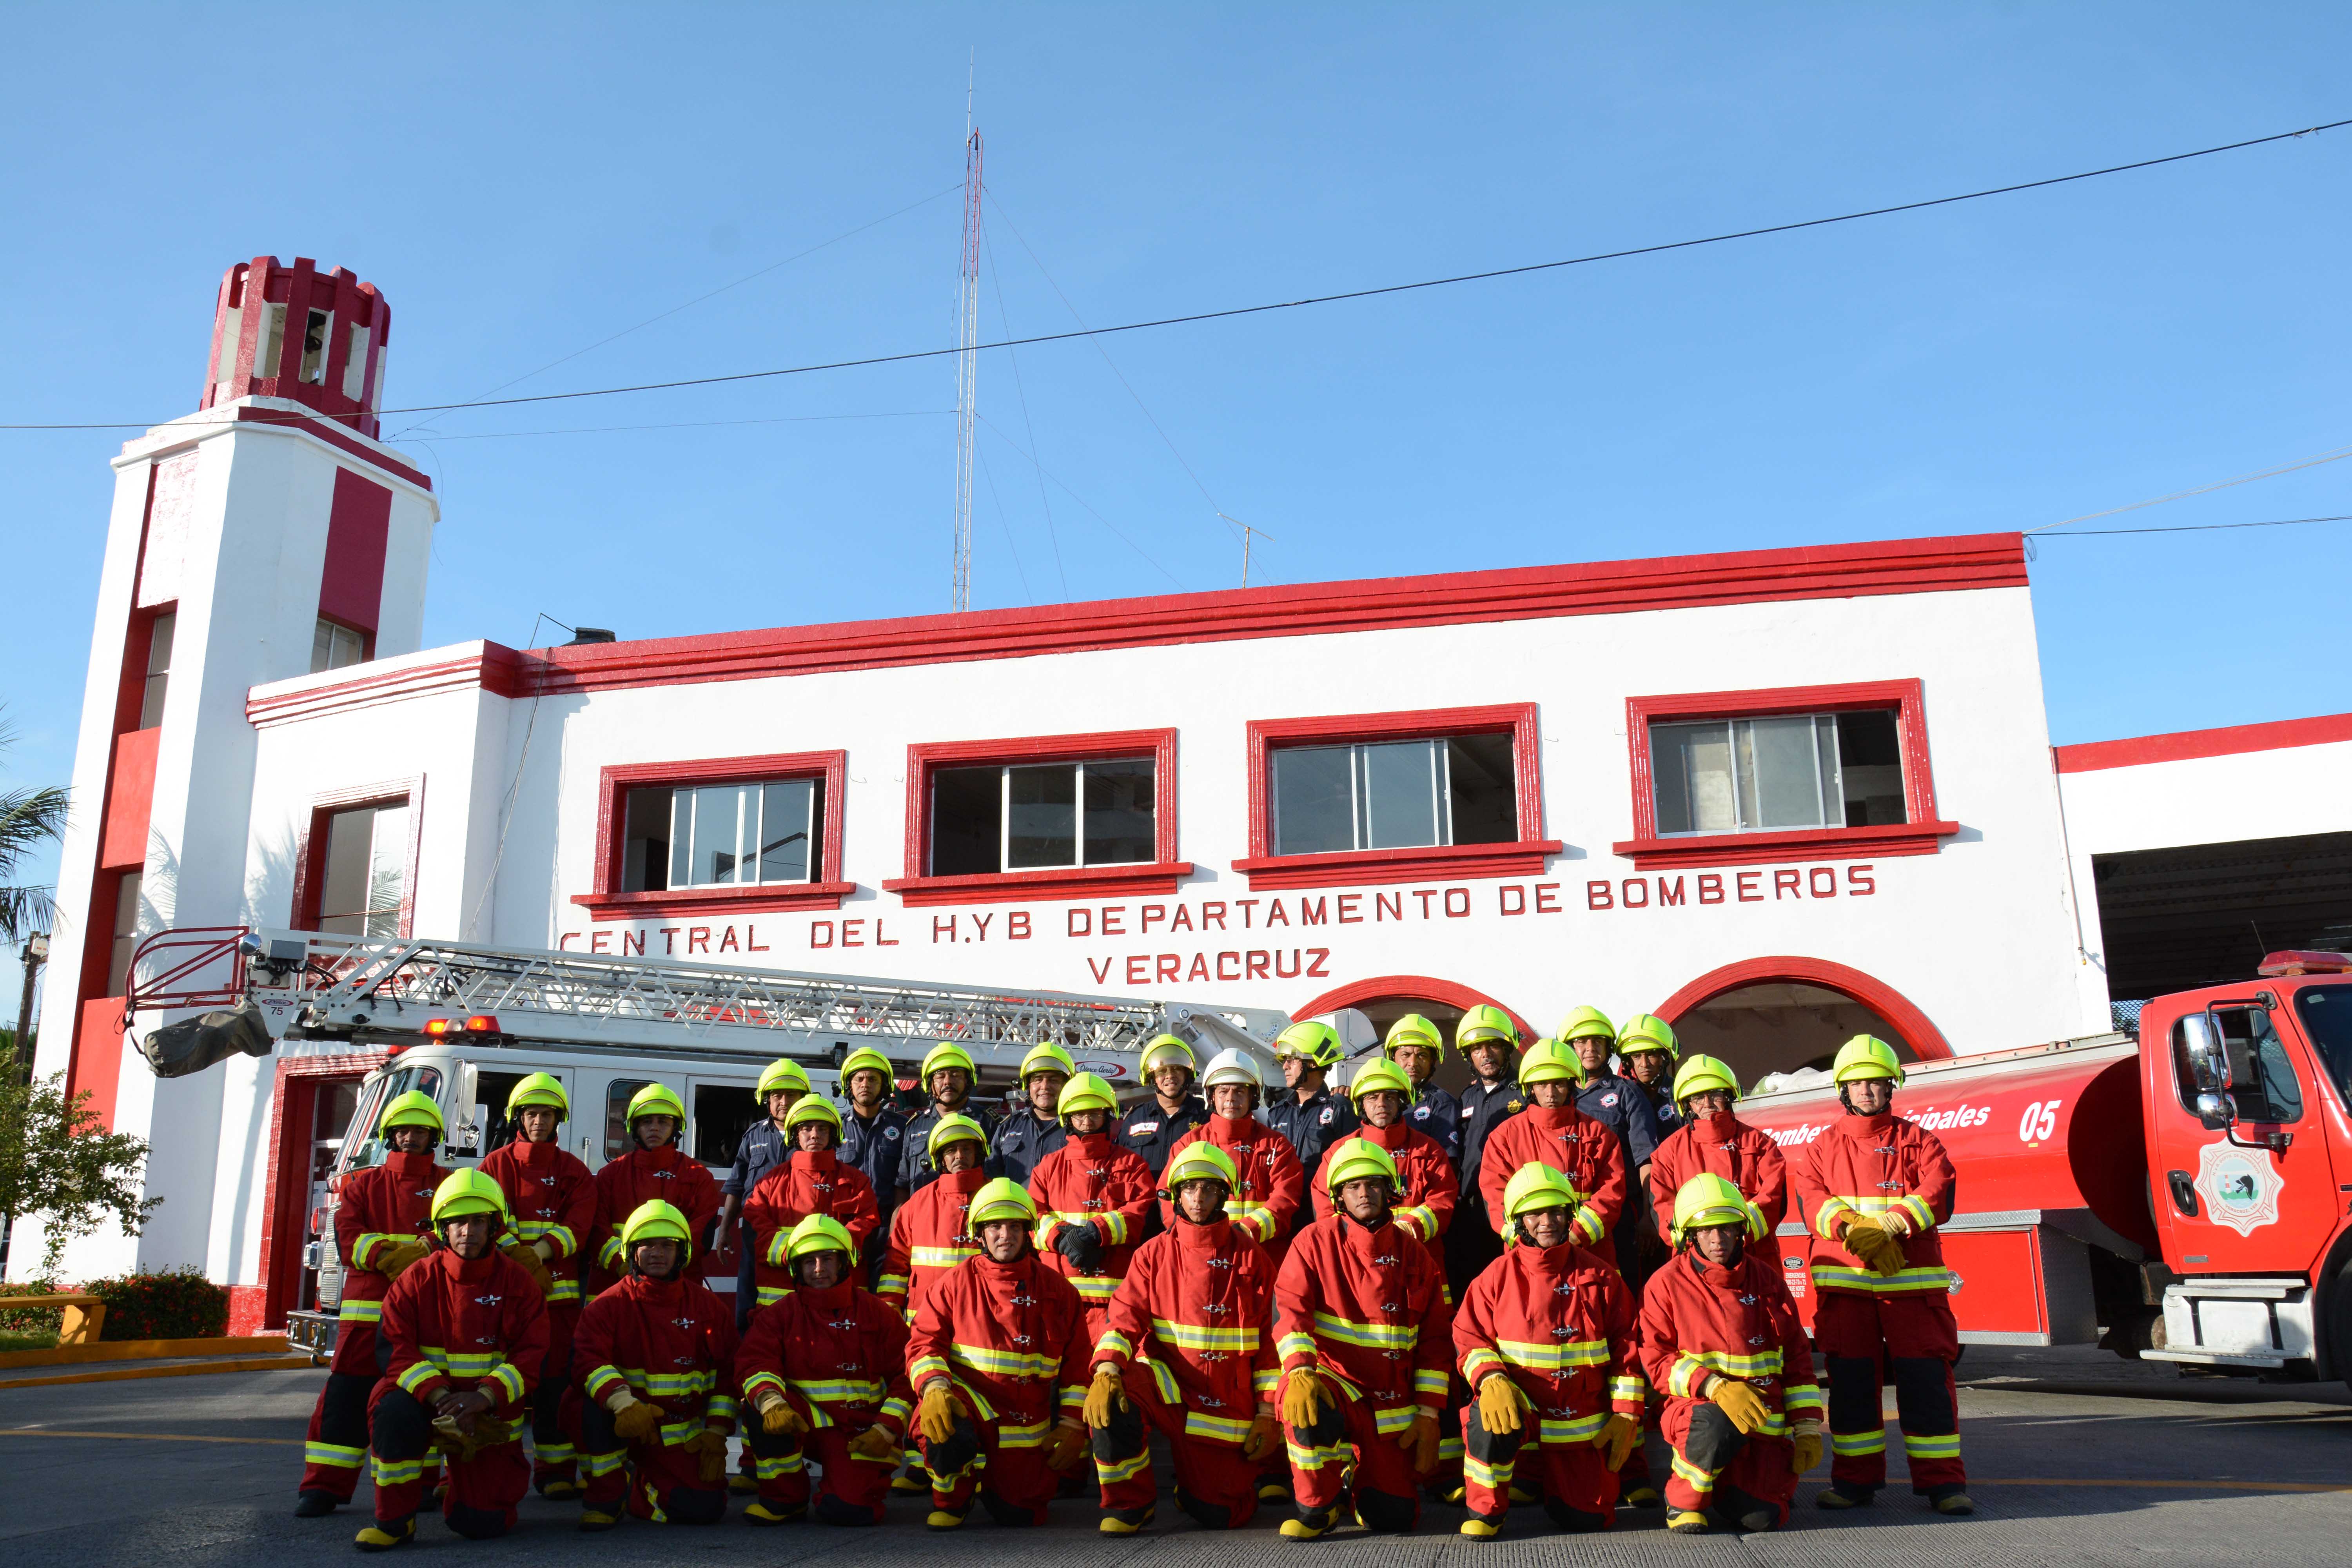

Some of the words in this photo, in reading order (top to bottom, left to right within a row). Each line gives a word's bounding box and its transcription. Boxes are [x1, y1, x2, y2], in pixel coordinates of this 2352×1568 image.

[560, 925, 770, 956] CENTRAL
[811, 919, 899, 949] DEL
[1069, 888, 1471, 937] DEPARTAMENTO
[1501, 883, 1563, 916] DE
[1588, 865, 1875, 911] BOMBEROS
[1089, 948, 1330, 985] VERACRUZ
[271, 1007, 283, 1015] 75
[2019, 1100, 2062, 1142] 05
